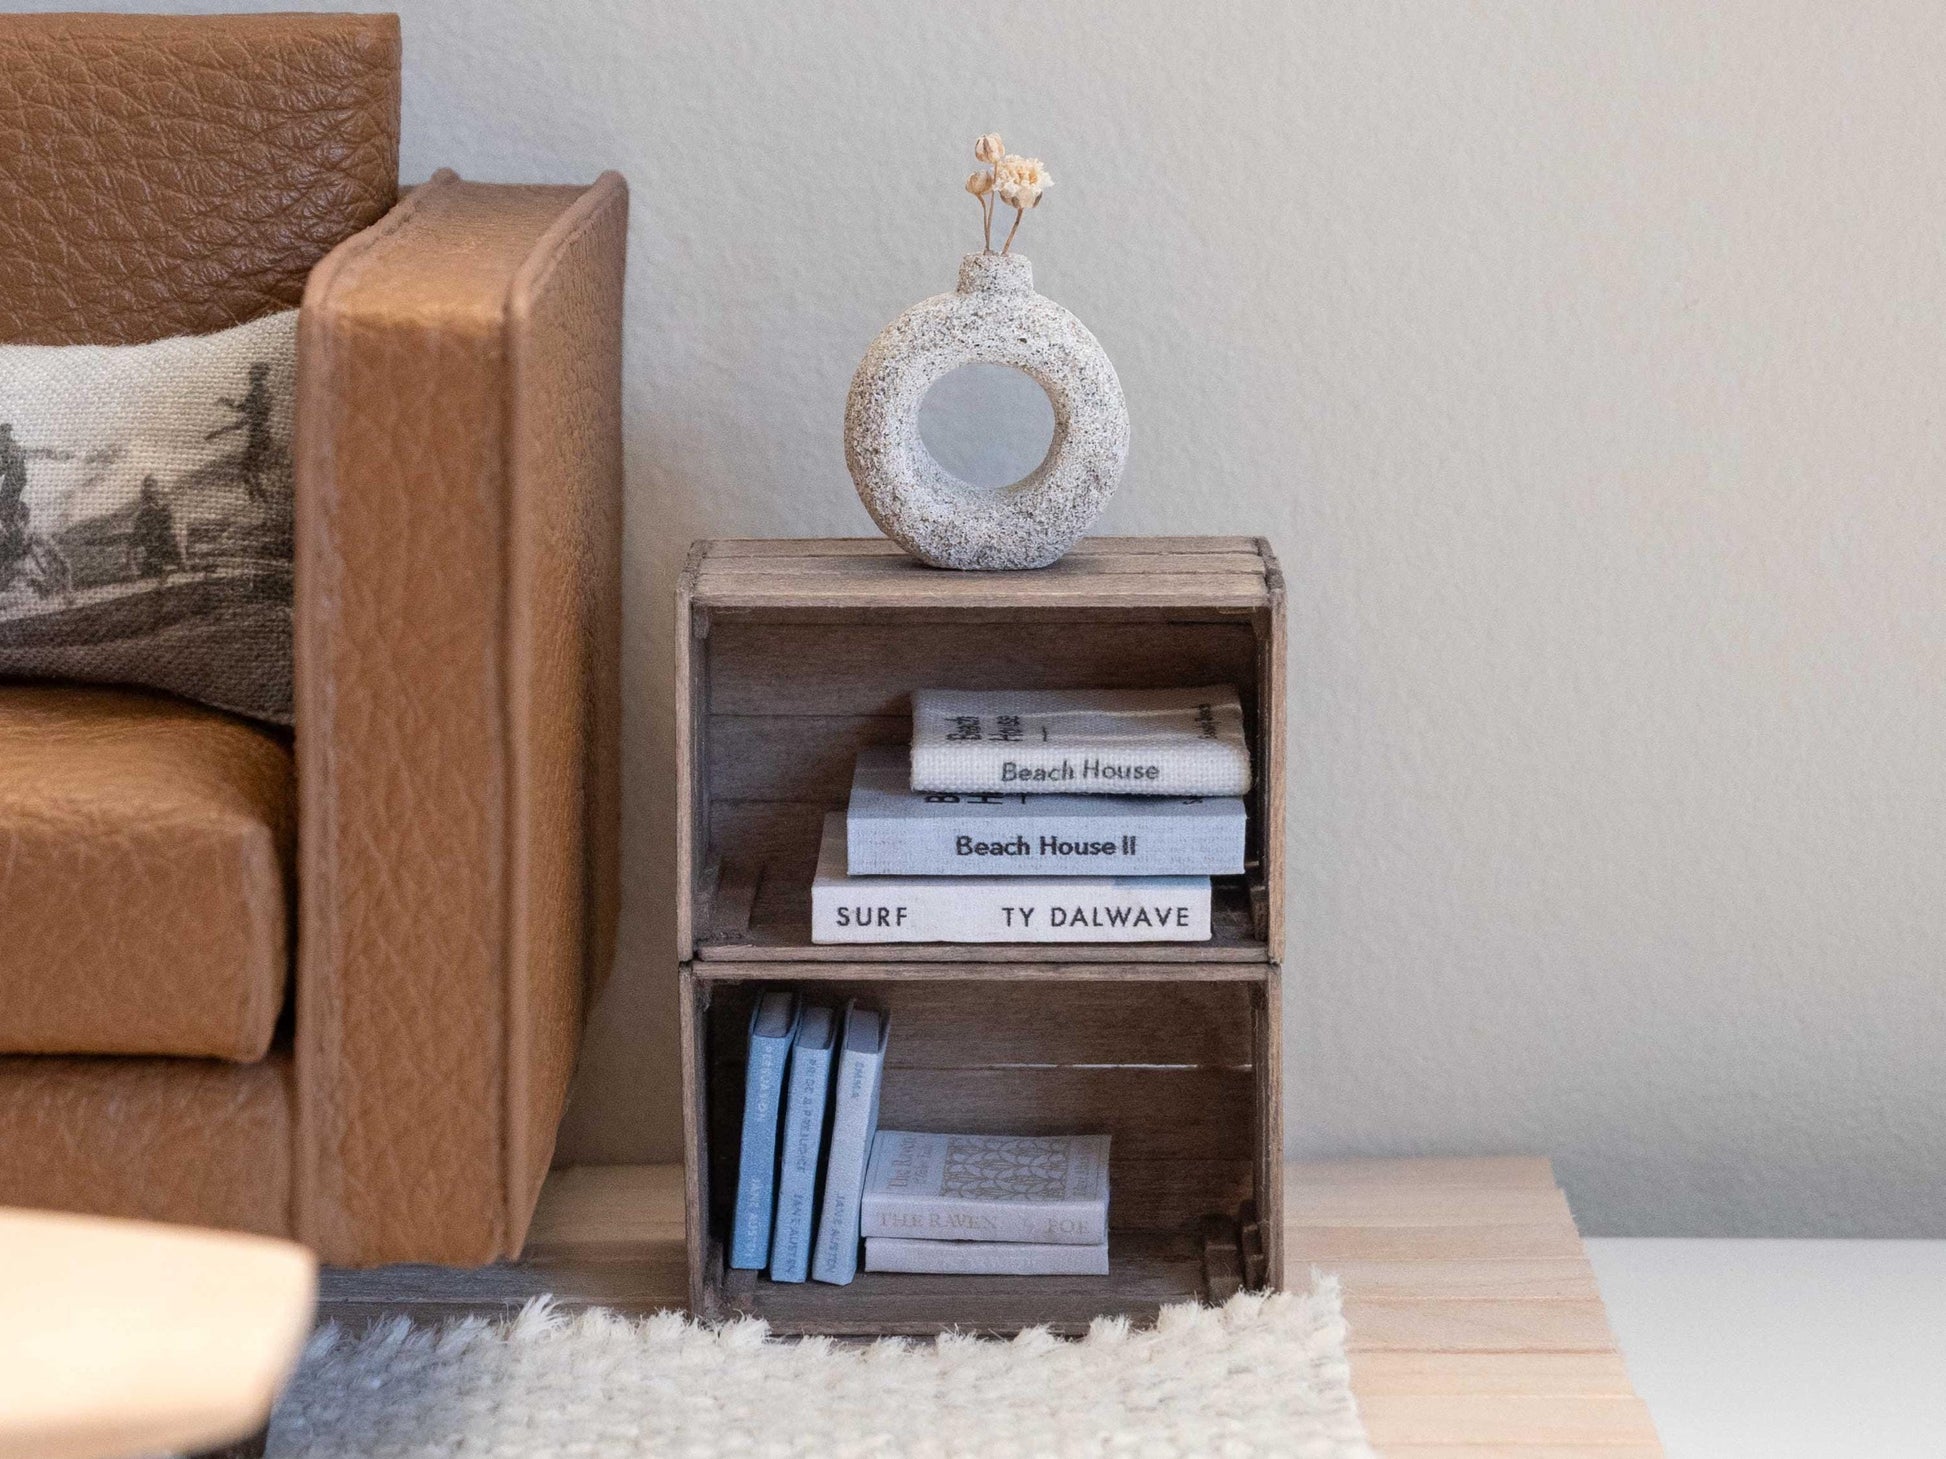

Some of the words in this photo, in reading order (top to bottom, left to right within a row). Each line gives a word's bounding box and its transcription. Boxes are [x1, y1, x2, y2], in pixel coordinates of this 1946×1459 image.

[1001, 760, 1073, 782] Beach
[1083, 759, 1160, 780] House
[956, 836, 1030, 856] Beach
[1039, 836, 1117, 856] House
[1122, 836, 1136, 855] II
[836, 906, 908, 927] SURF
[1001, 906, 1035, 927] TY
[1050, 906, 1190, 927] DALWAVE
[877, 1211, 922, 1229] THE
[928, 1212, 999, 1230] RAVEN
